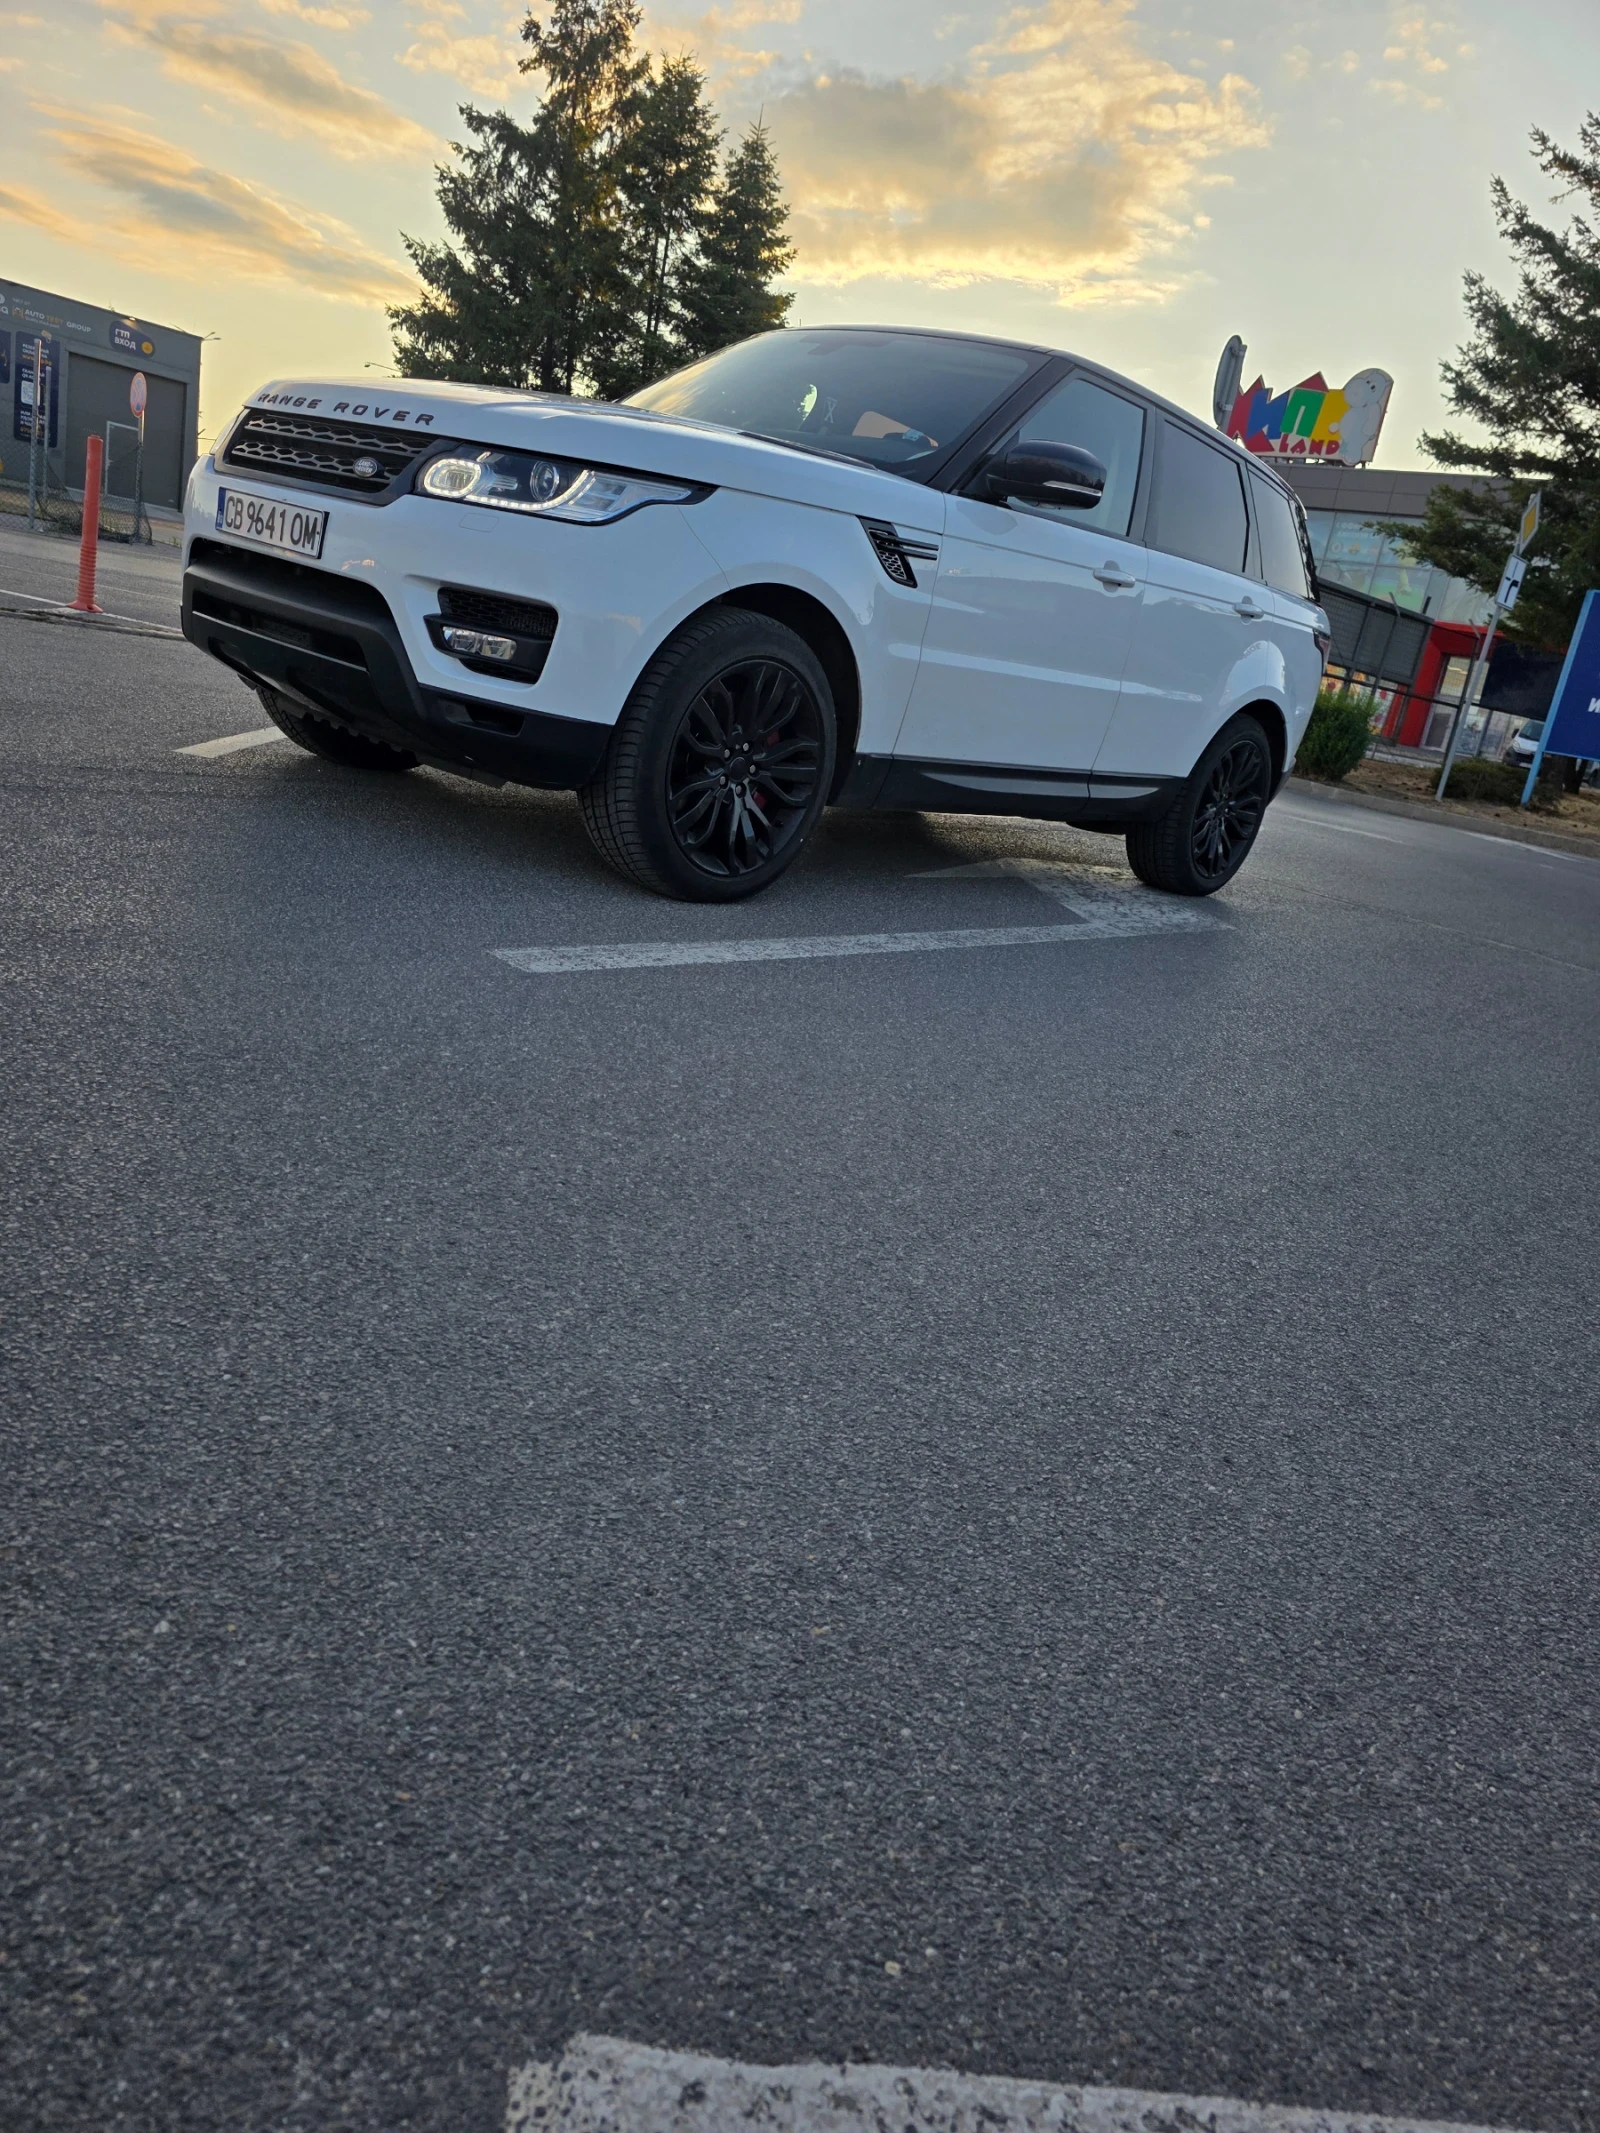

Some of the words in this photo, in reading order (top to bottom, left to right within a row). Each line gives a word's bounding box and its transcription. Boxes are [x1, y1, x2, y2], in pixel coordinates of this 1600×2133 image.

[25, 309, 45, 320] AUTO
[66, 321, 92, 333] GROUP
[114, 336, 137, 350] ВХОД
[115, 328, 130, 339] ГТП
[257, 393, 322, 409] RANGE
[333, 402, 435, 426] ROVER
[1278, 433, 1340, 456] LAND
[246, 500, 287, 542] 9641
